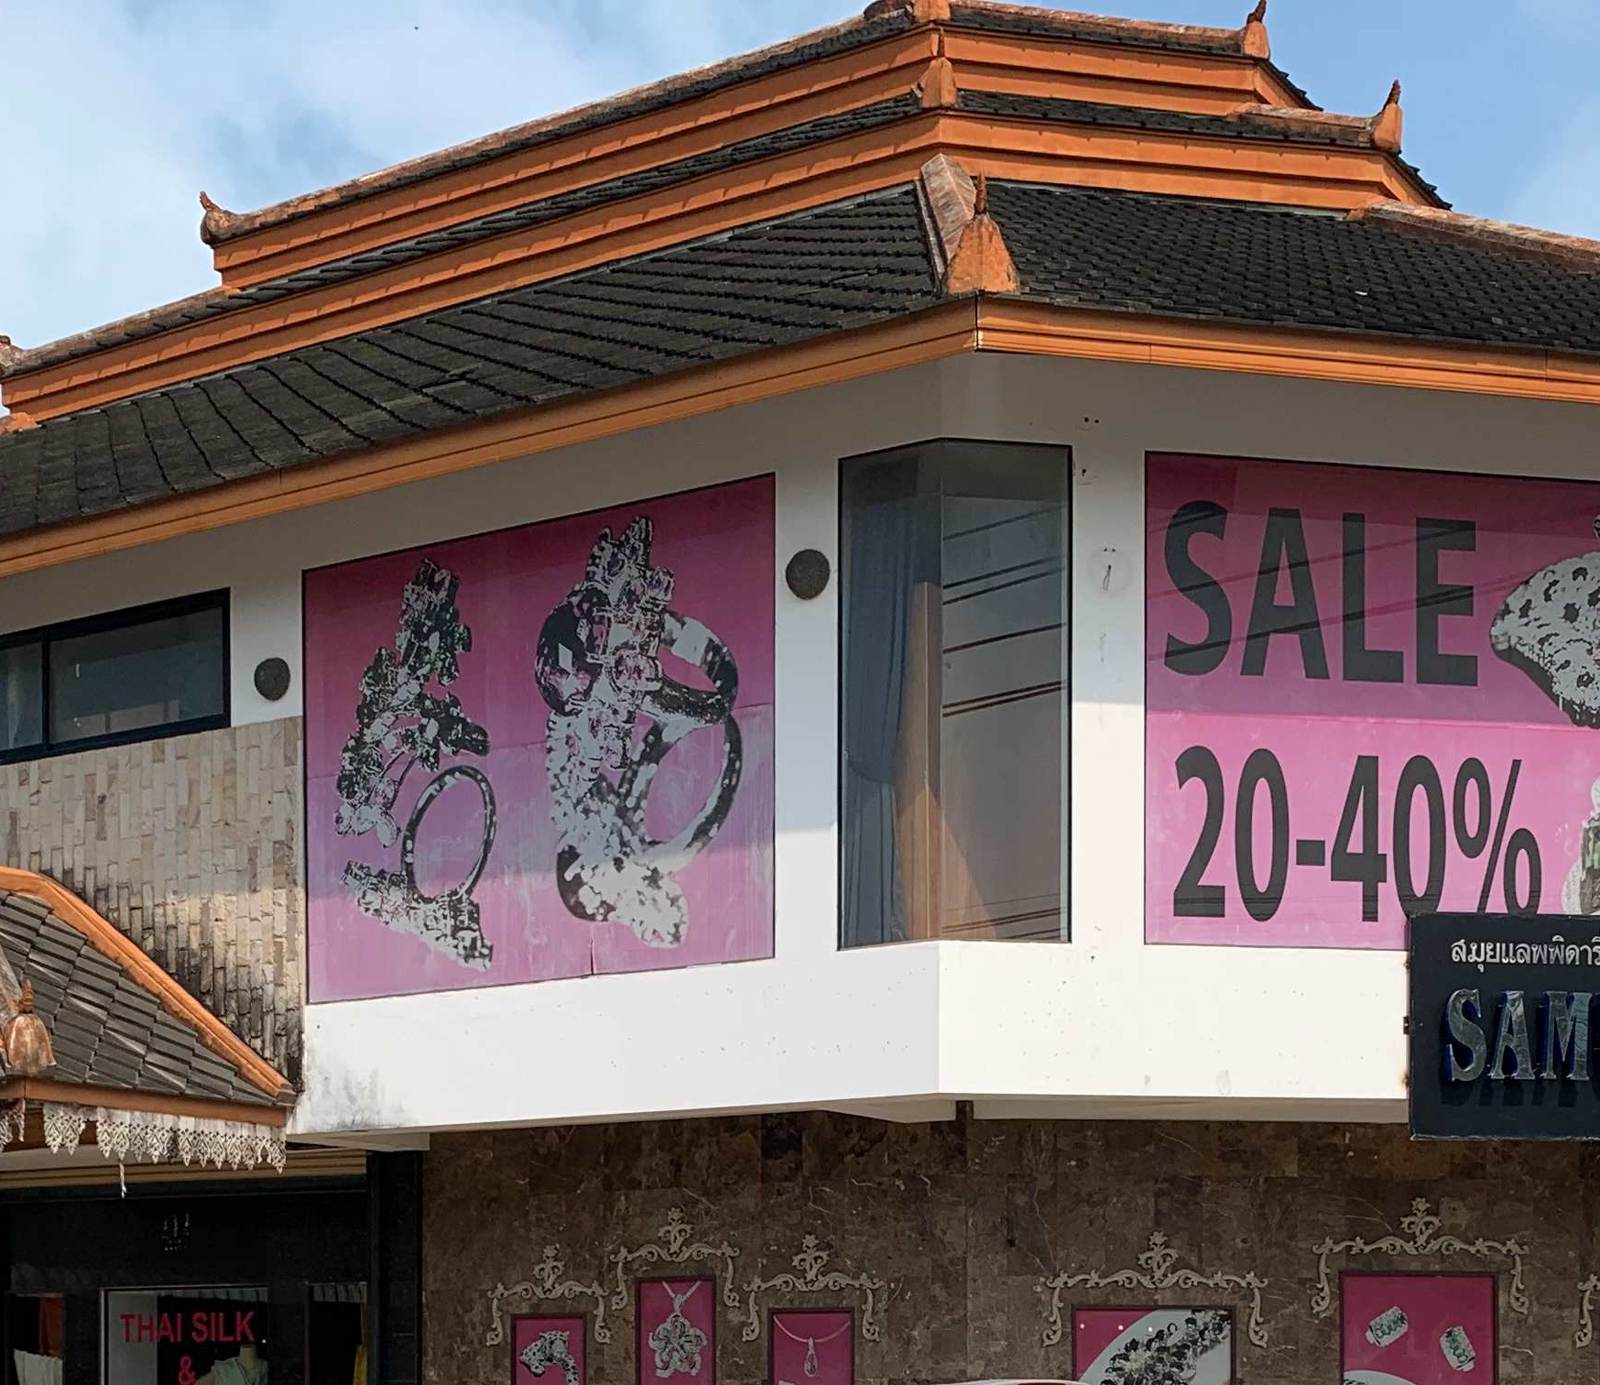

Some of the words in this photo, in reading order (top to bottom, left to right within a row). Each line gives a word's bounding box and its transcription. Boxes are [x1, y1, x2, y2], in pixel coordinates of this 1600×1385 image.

[1163, 500, 1480, 687] SALE
[1173, 744, 1543, 923] 20-40%
[1447, 987, 1600, 1082] SAM
[120, 1312, 183, 1343] THAI
[191, 1311, 256, 1343] SILK
